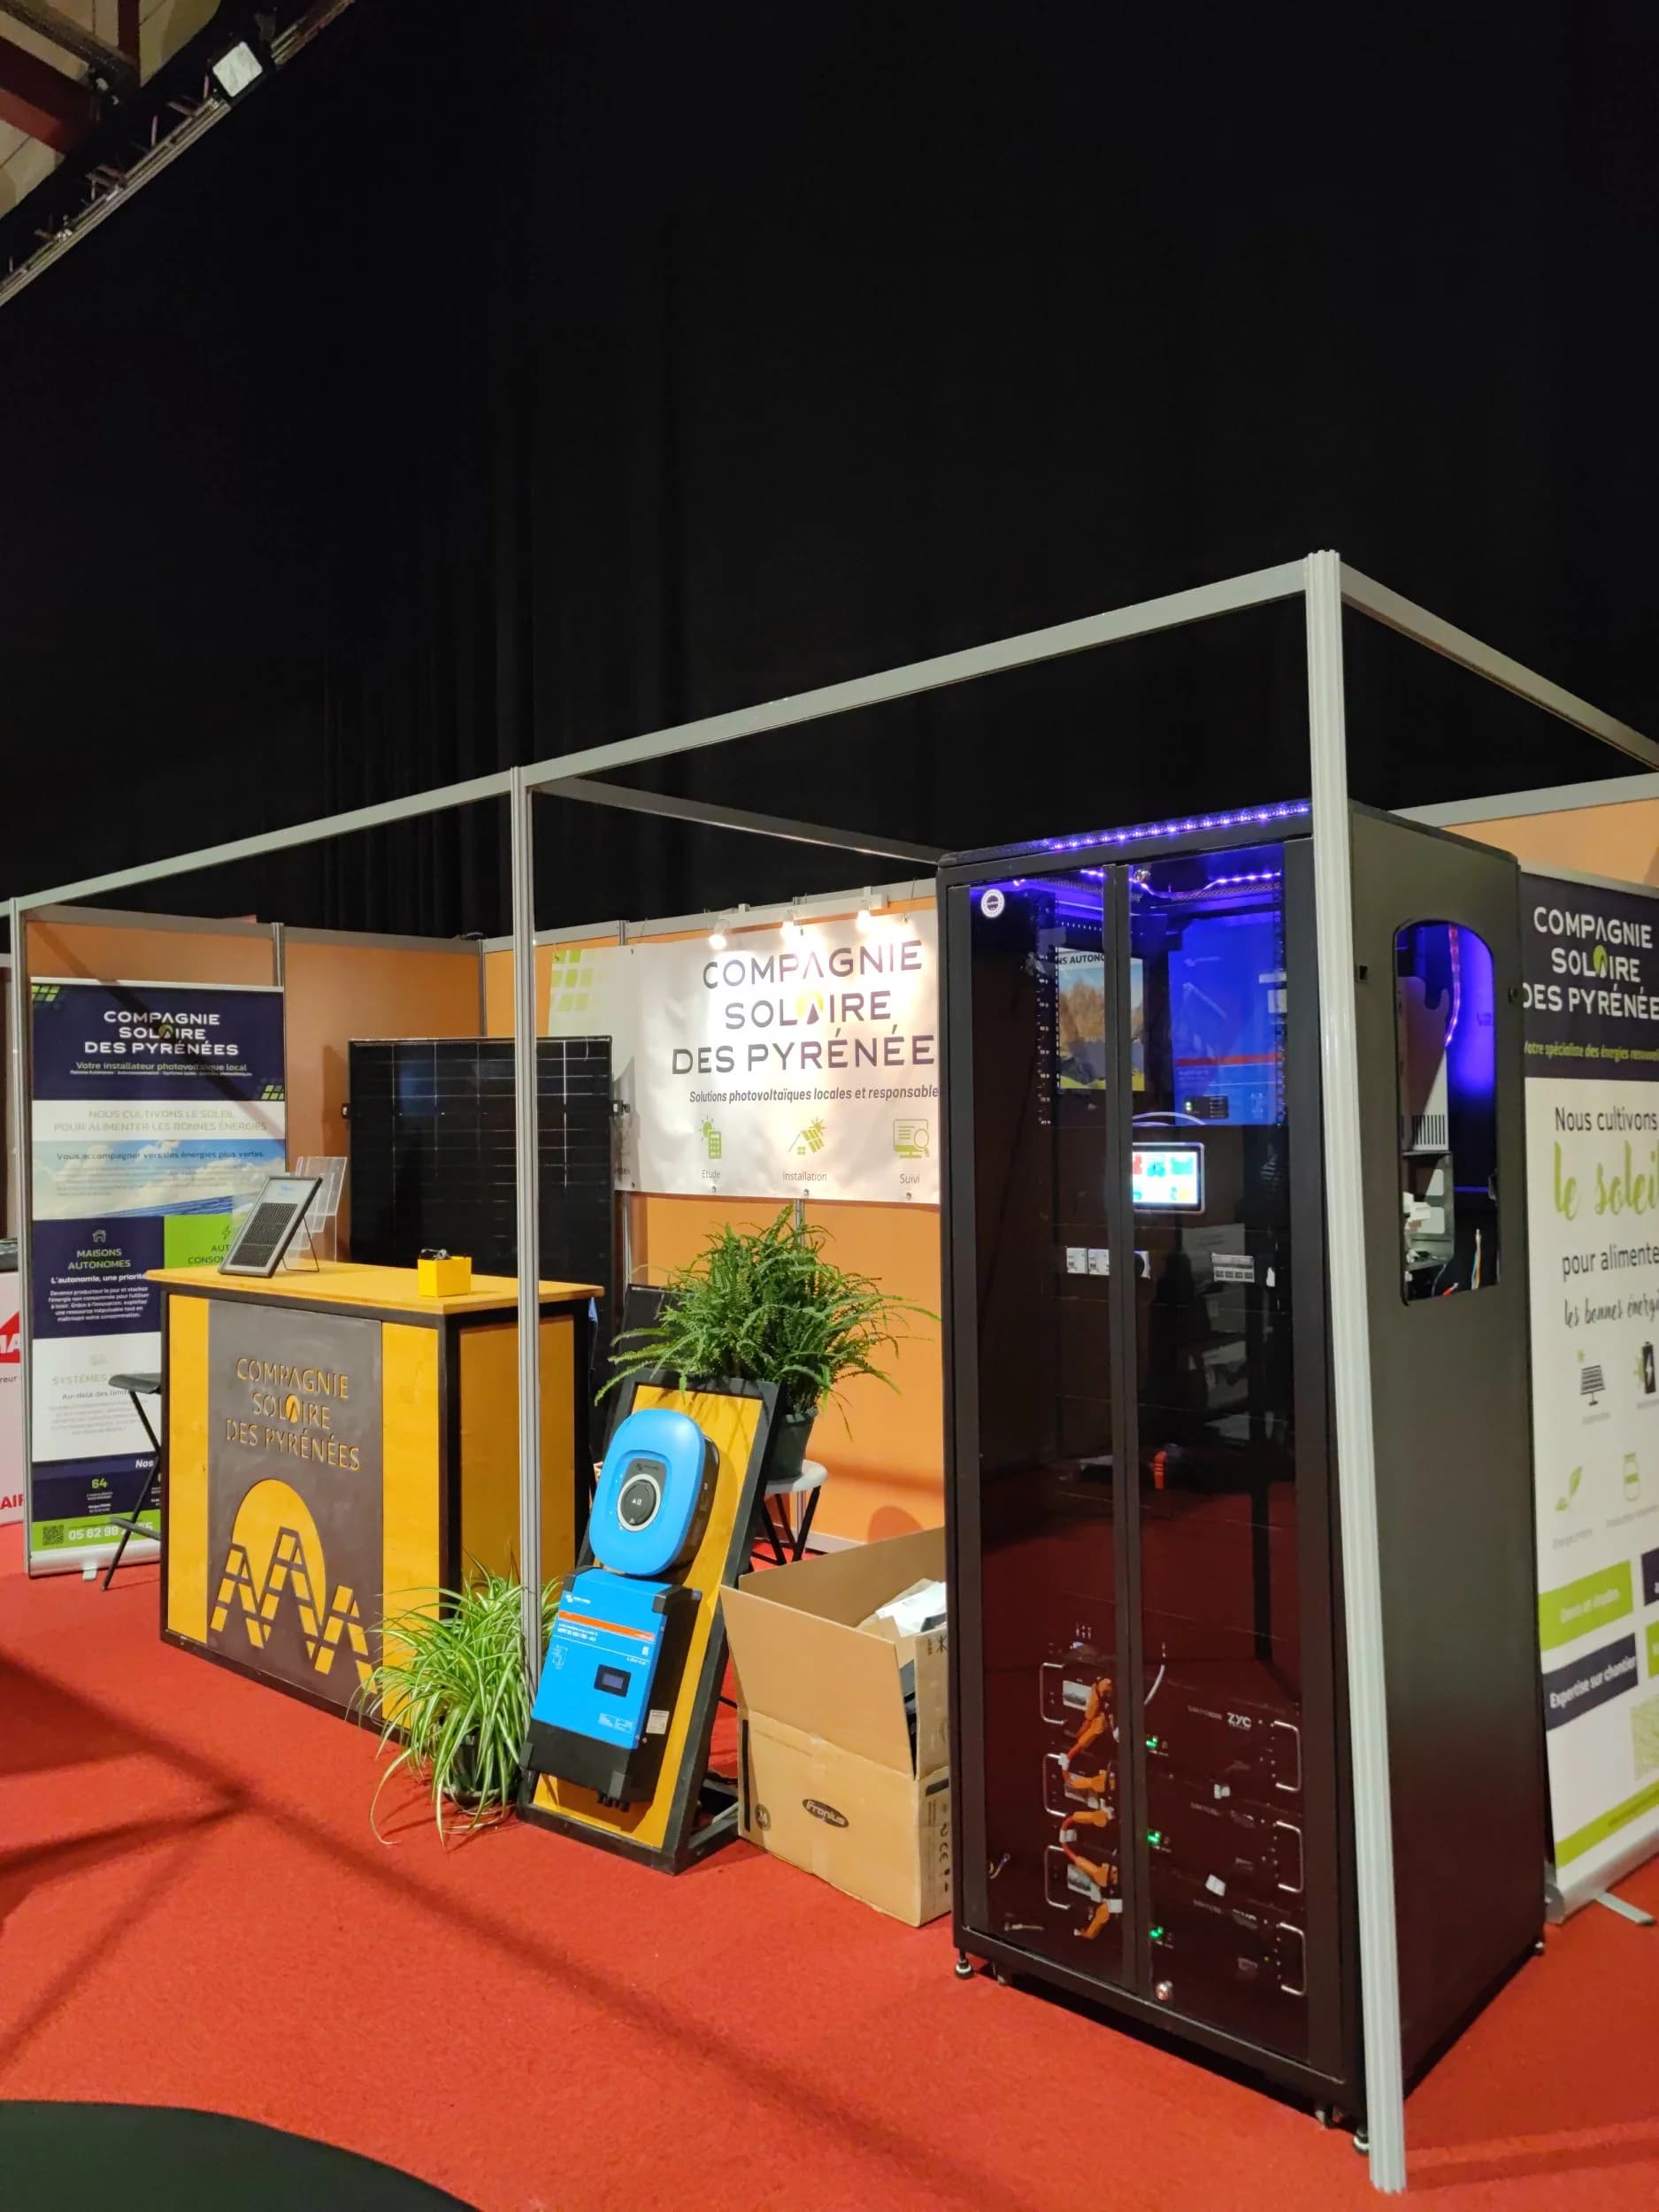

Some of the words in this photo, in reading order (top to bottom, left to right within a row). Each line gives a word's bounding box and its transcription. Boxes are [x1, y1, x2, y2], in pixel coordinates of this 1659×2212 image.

[1533, 906, 1653, 949] COMPAGNIE
[703, 940, 922, 989] COMPAGNIE
[1551, 945, 1641, 983] SOLAIRE
[104, 1010, 220, 1025] COMPAGNIE
[725, 990, 891, 1031] SOLAIRE
[119, 1025, 206, 1041] SOLAIRE
[84, 1041, 127, 1054] DES
[132, 1040, 239, 1056] PYRÉNÉES
[672, 1045, 735, 1075] DES
[748, 1024, 935, 1072] PYRÉNÉE
[689, 1089, 727, 1103] Solutions
[728, 1087, 811, 1105] photovoltaïques
[813, 1087, 852, 1101] locales
[855, 1087, 866, 1100] et
[868, 1084, 940, 1102] responsable
[1555, 1106, 1592, 1132] Nous
[1596, 1105, 1657, 1132] cultivons
[782, 1170, 827, 1182] Installation
[899, 1172, 920, 1185] Suivi
[1554, 1140, 1581, 1221] le
[76, 1248, 122, 1258] MAISONS
[67, 1259, 131, 1271] AUTONOMES
[1562, 1251, 1595, 1283] pour
[50, 1275, 102, 1285] L'autonomie,
[236, 1357, 349, 1400] COMPAGNIE
[252, 1391, 330, 1431] SOLAIRE
[226, 1418, 257, 1446] DES
[265, 1427, 360, 1471] PYRÉNÉES
[135, 1459, 154, 1469] Nos
[91, 1478, 108, 1489] 64
[68, 1528, 85, 1540] 05
[805, 1800, 846, 1826] Fronius
